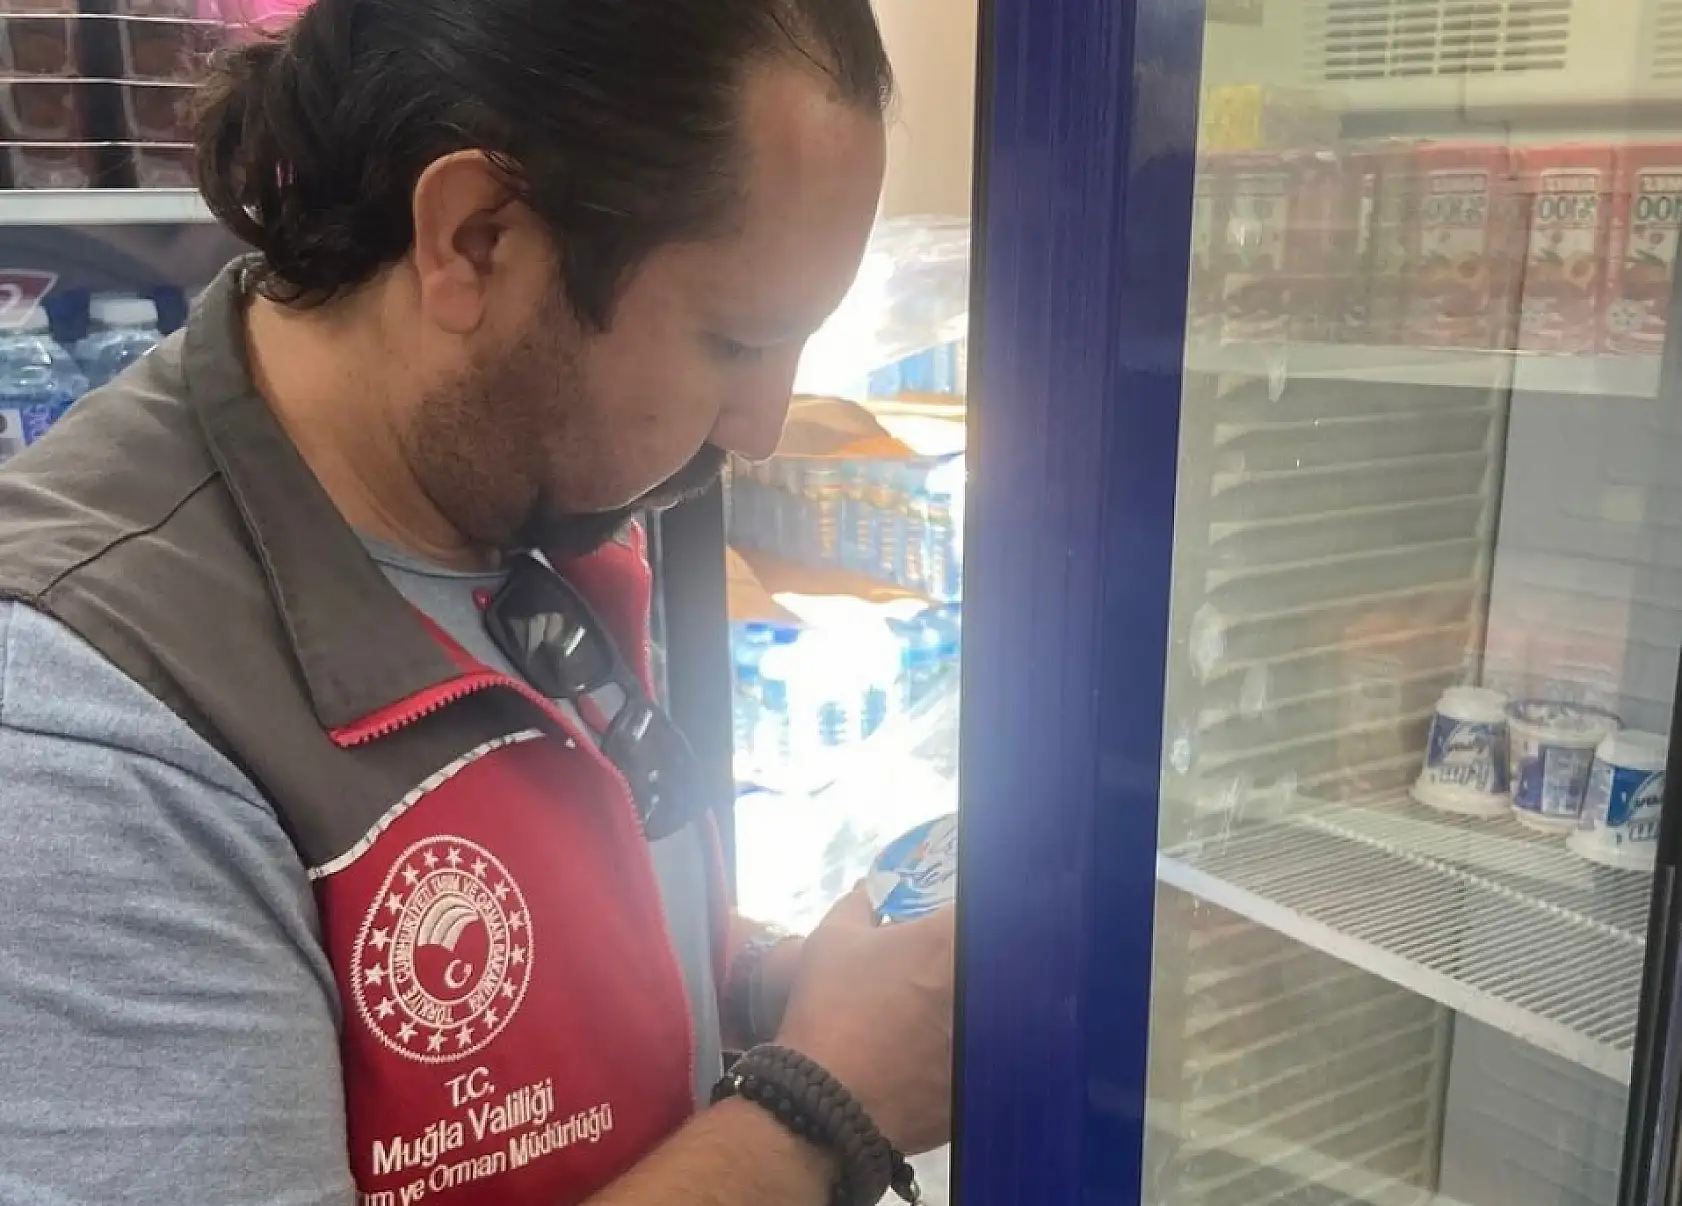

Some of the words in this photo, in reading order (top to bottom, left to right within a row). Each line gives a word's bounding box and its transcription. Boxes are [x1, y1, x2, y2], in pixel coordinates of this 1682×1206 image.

[371, 1119, 464, 1175] Muğla
[467, 1077, 554, 1141] Valiliği
[443, 1066, 495, 1107] T.C.
[428, 1150, 506, 1192] Orman
[509, 1101, 613, 1169] Müdürlüğü
